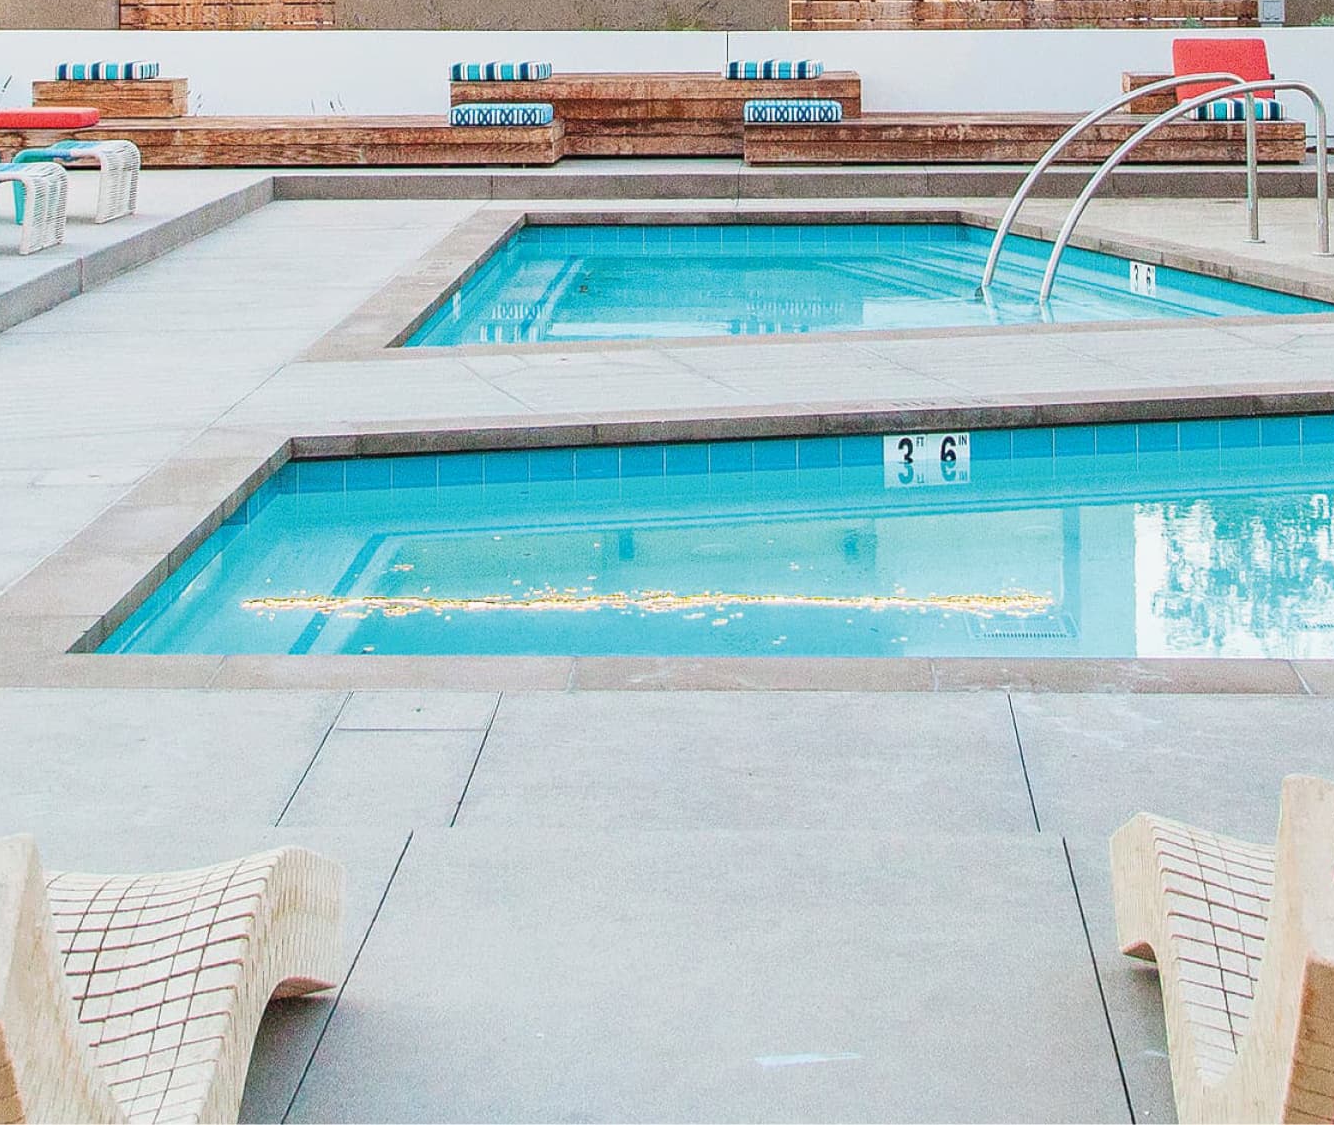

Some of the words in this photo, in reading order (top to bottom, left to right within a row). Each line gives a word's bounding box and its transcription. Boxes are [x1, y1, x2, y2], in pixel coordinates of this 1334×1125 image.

[898, 437, 914, 465] 3
[916, 437, 924, 446] FT
[940, 435, 957, 463] 6
[958, 435, 967, 445] IN
